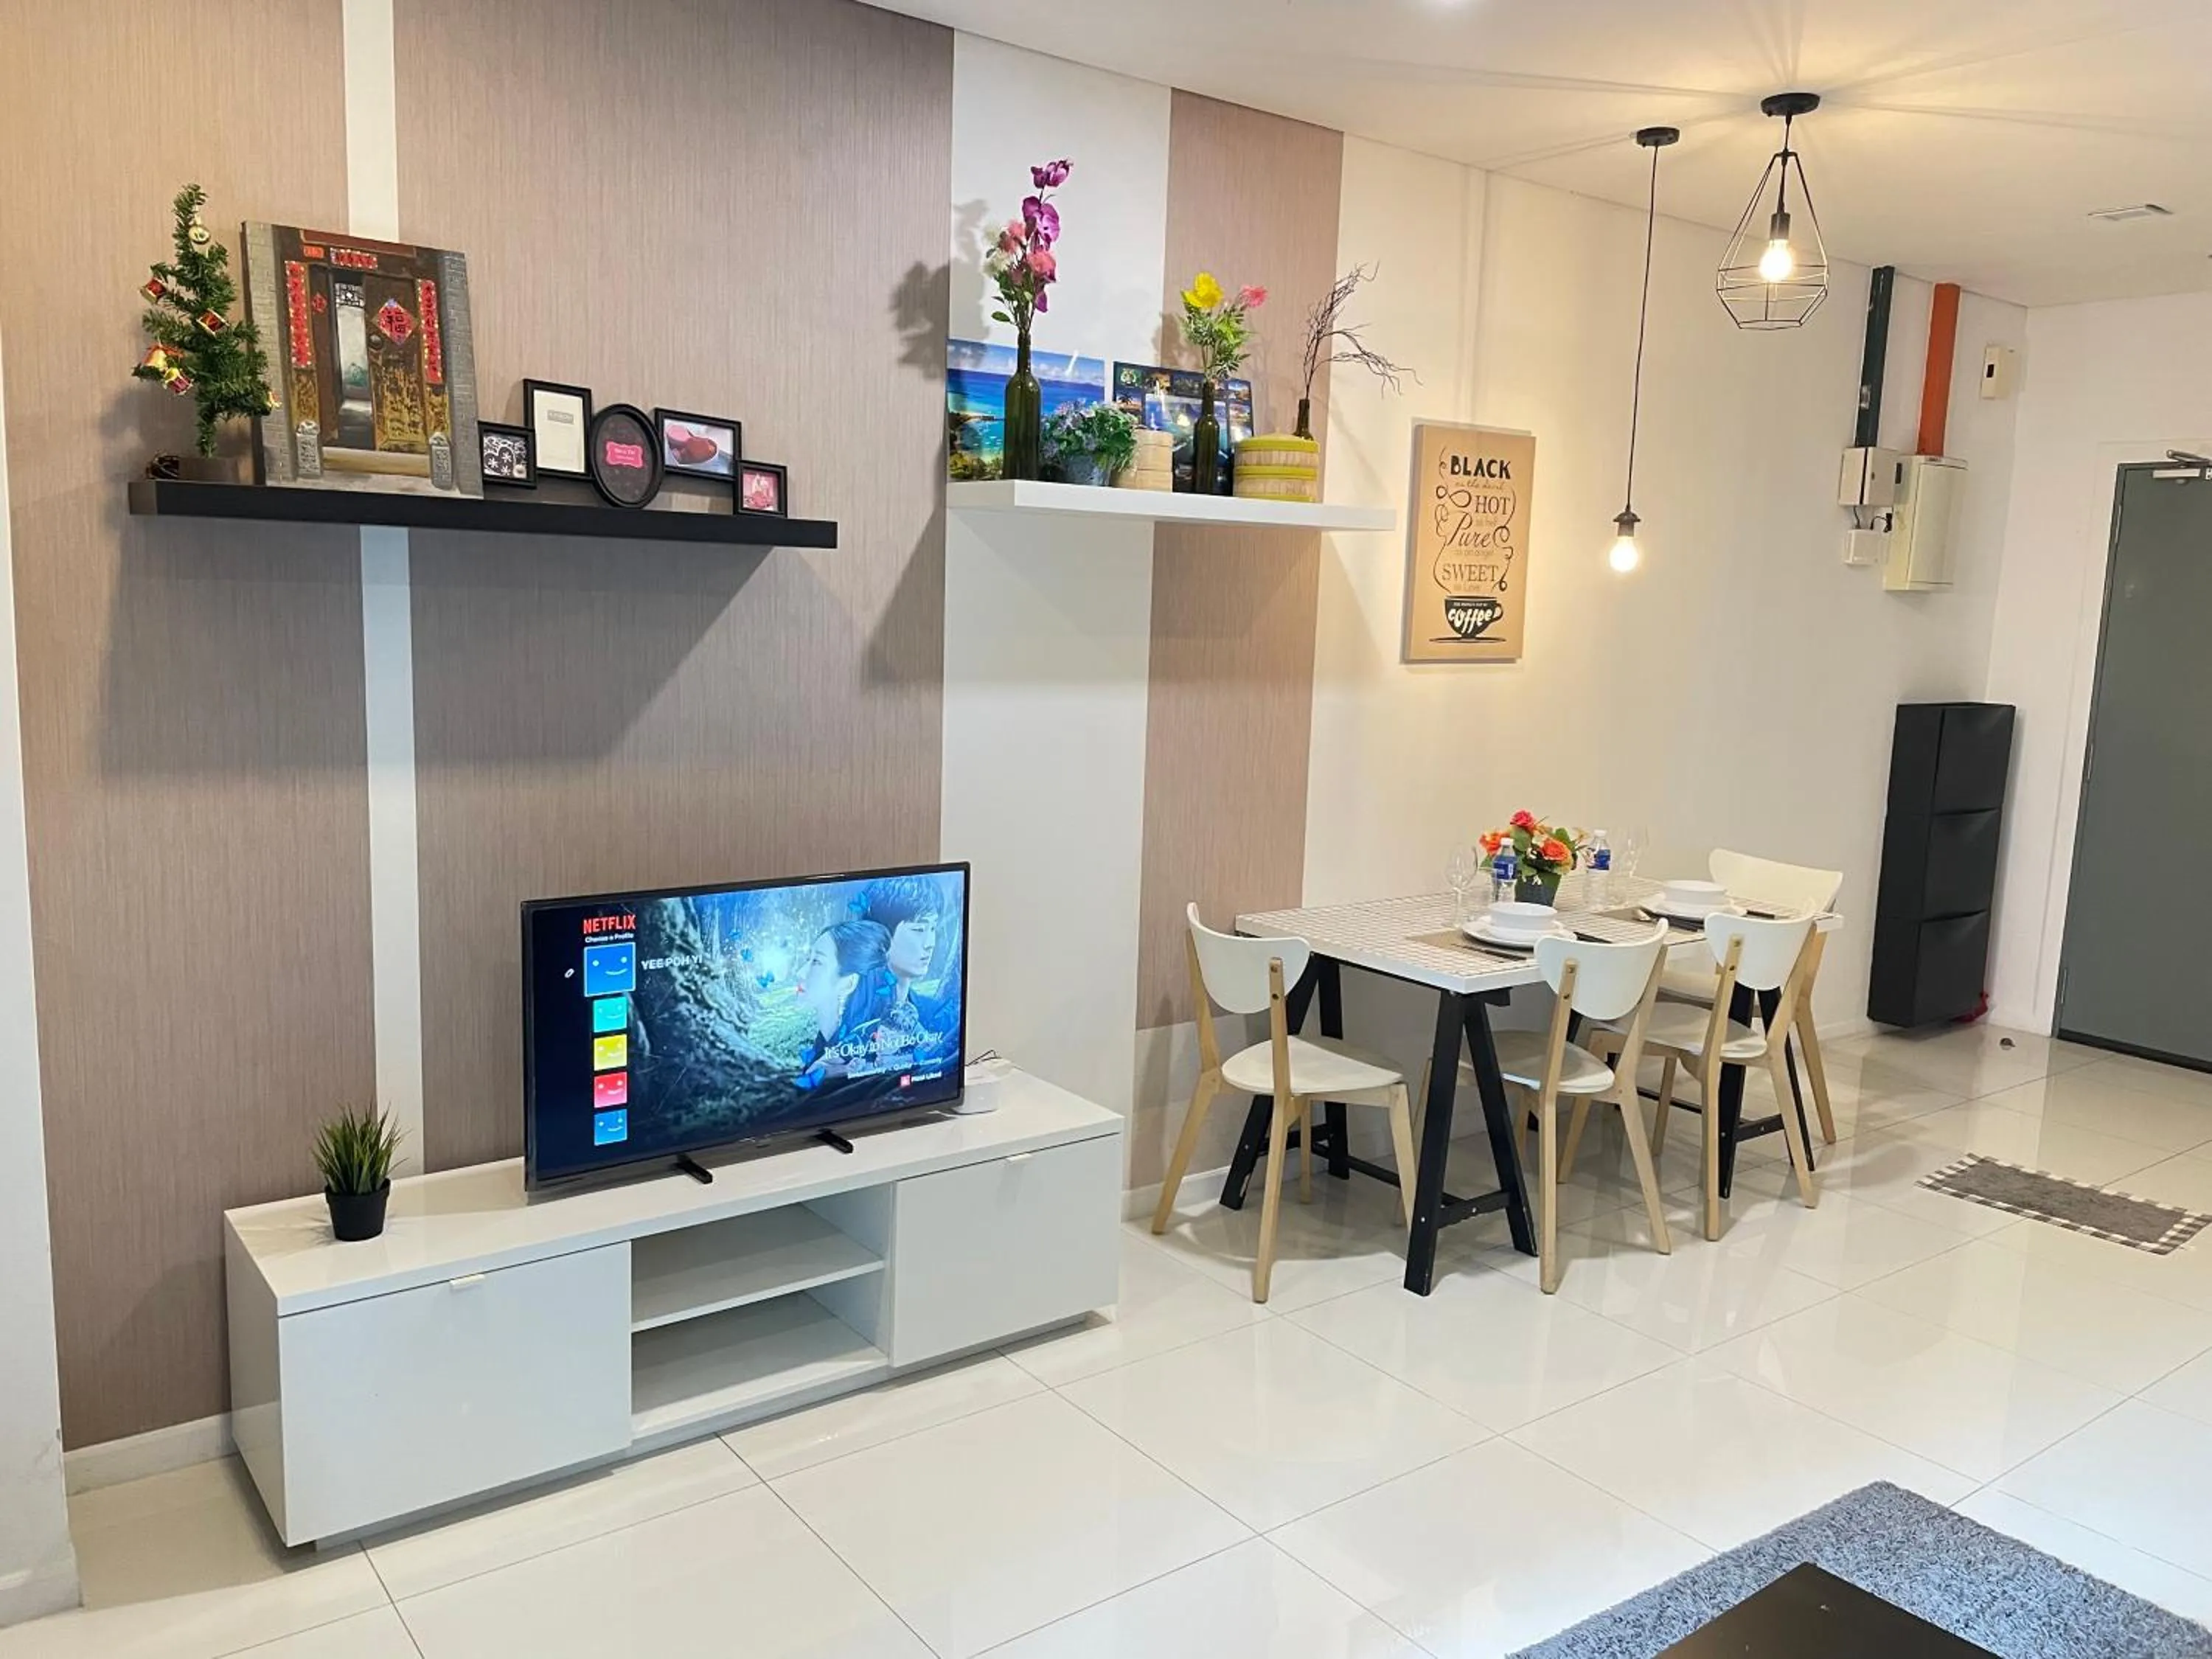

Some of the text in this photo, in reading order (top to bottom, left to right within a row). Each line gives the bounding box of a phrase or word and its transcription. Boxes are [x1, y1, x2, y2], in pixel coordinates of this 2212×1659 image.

[1450, 455, 1511, 479] BLACK
[1475, 495, 1510, 515] HOT
[1446, 511, 1491, 548] Pure
[1442, 563, 1499, 582] SWEET
[583, 914, 636, 934] NETFLIX
[641, 955, 703, 970] YEE POH YI
[824, 1046, 840, 1060] It's
[841, 1042, 869, 1059] Okay
